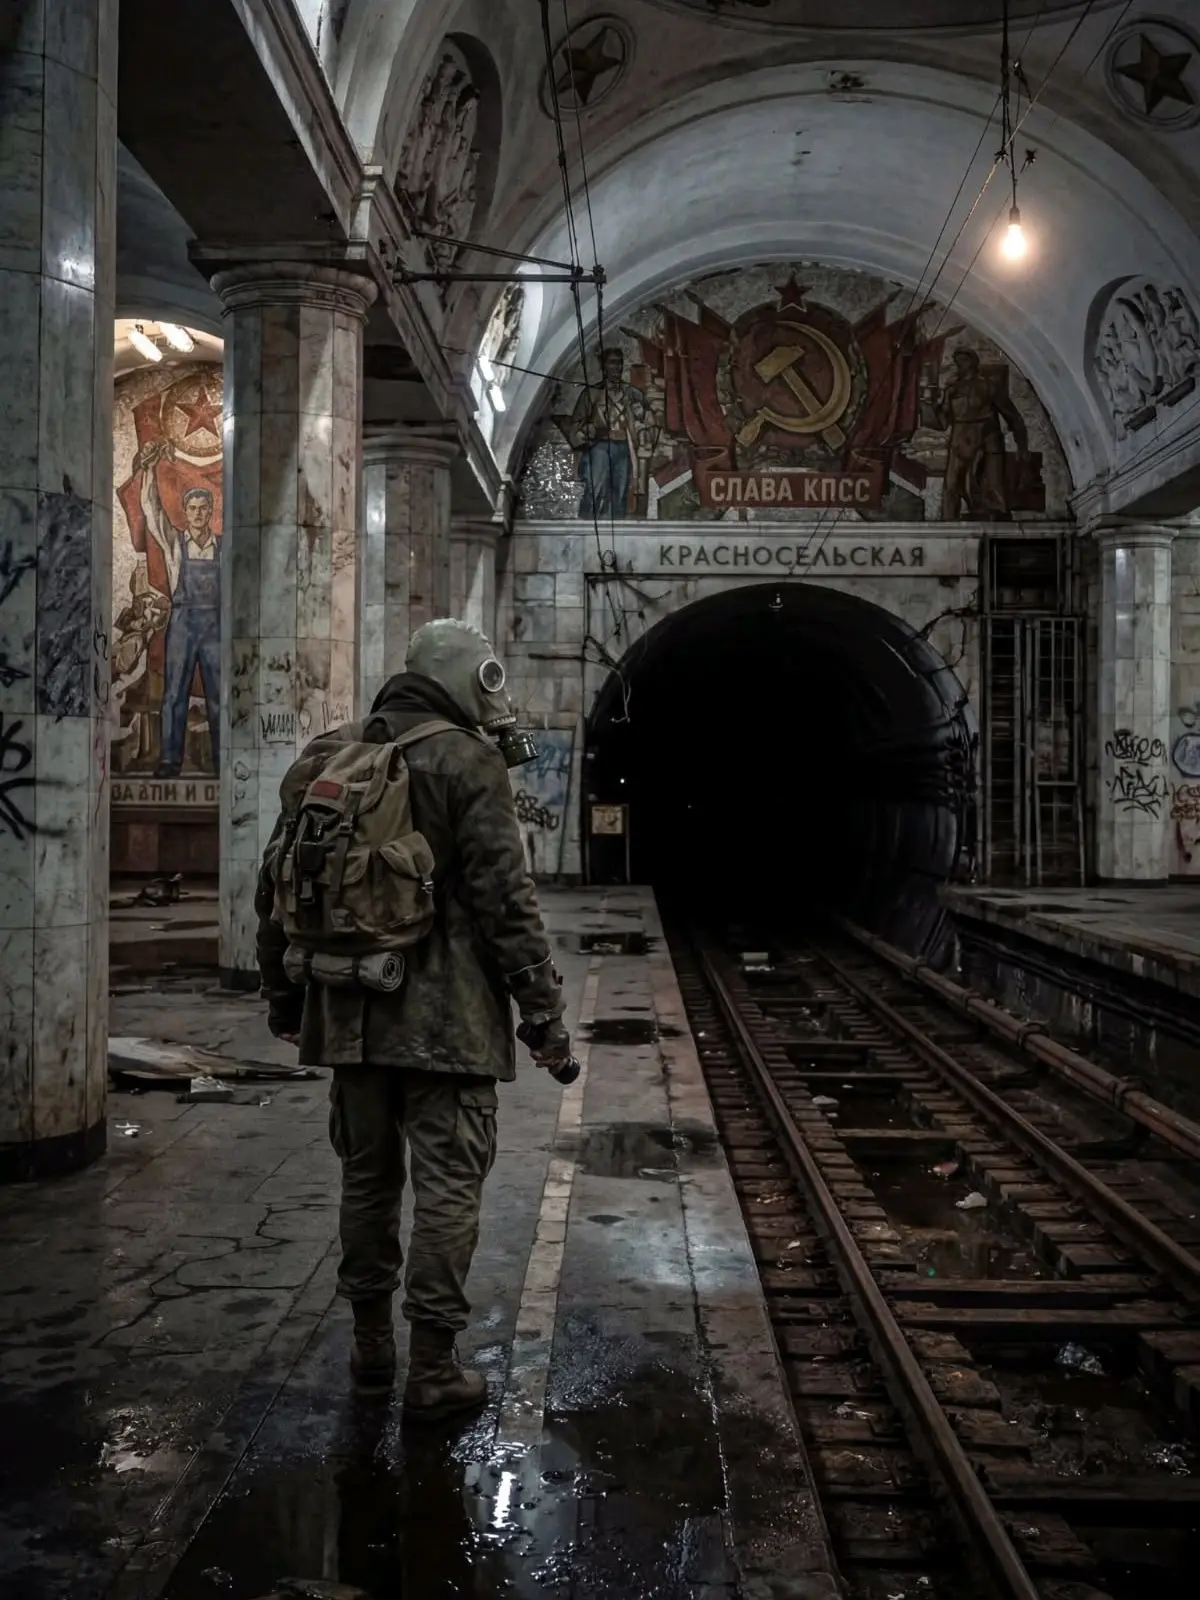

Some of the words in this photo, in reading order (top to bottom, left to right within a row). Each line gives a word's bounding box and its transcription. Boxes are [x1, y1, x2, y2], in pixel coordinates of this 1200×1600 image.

[710, 477, 793, 502] СЛАВА
[804, 477, 870, 502] КПСС
[659, 545, 925, 567] КРАСНОСЕЛЬСКАЯ
